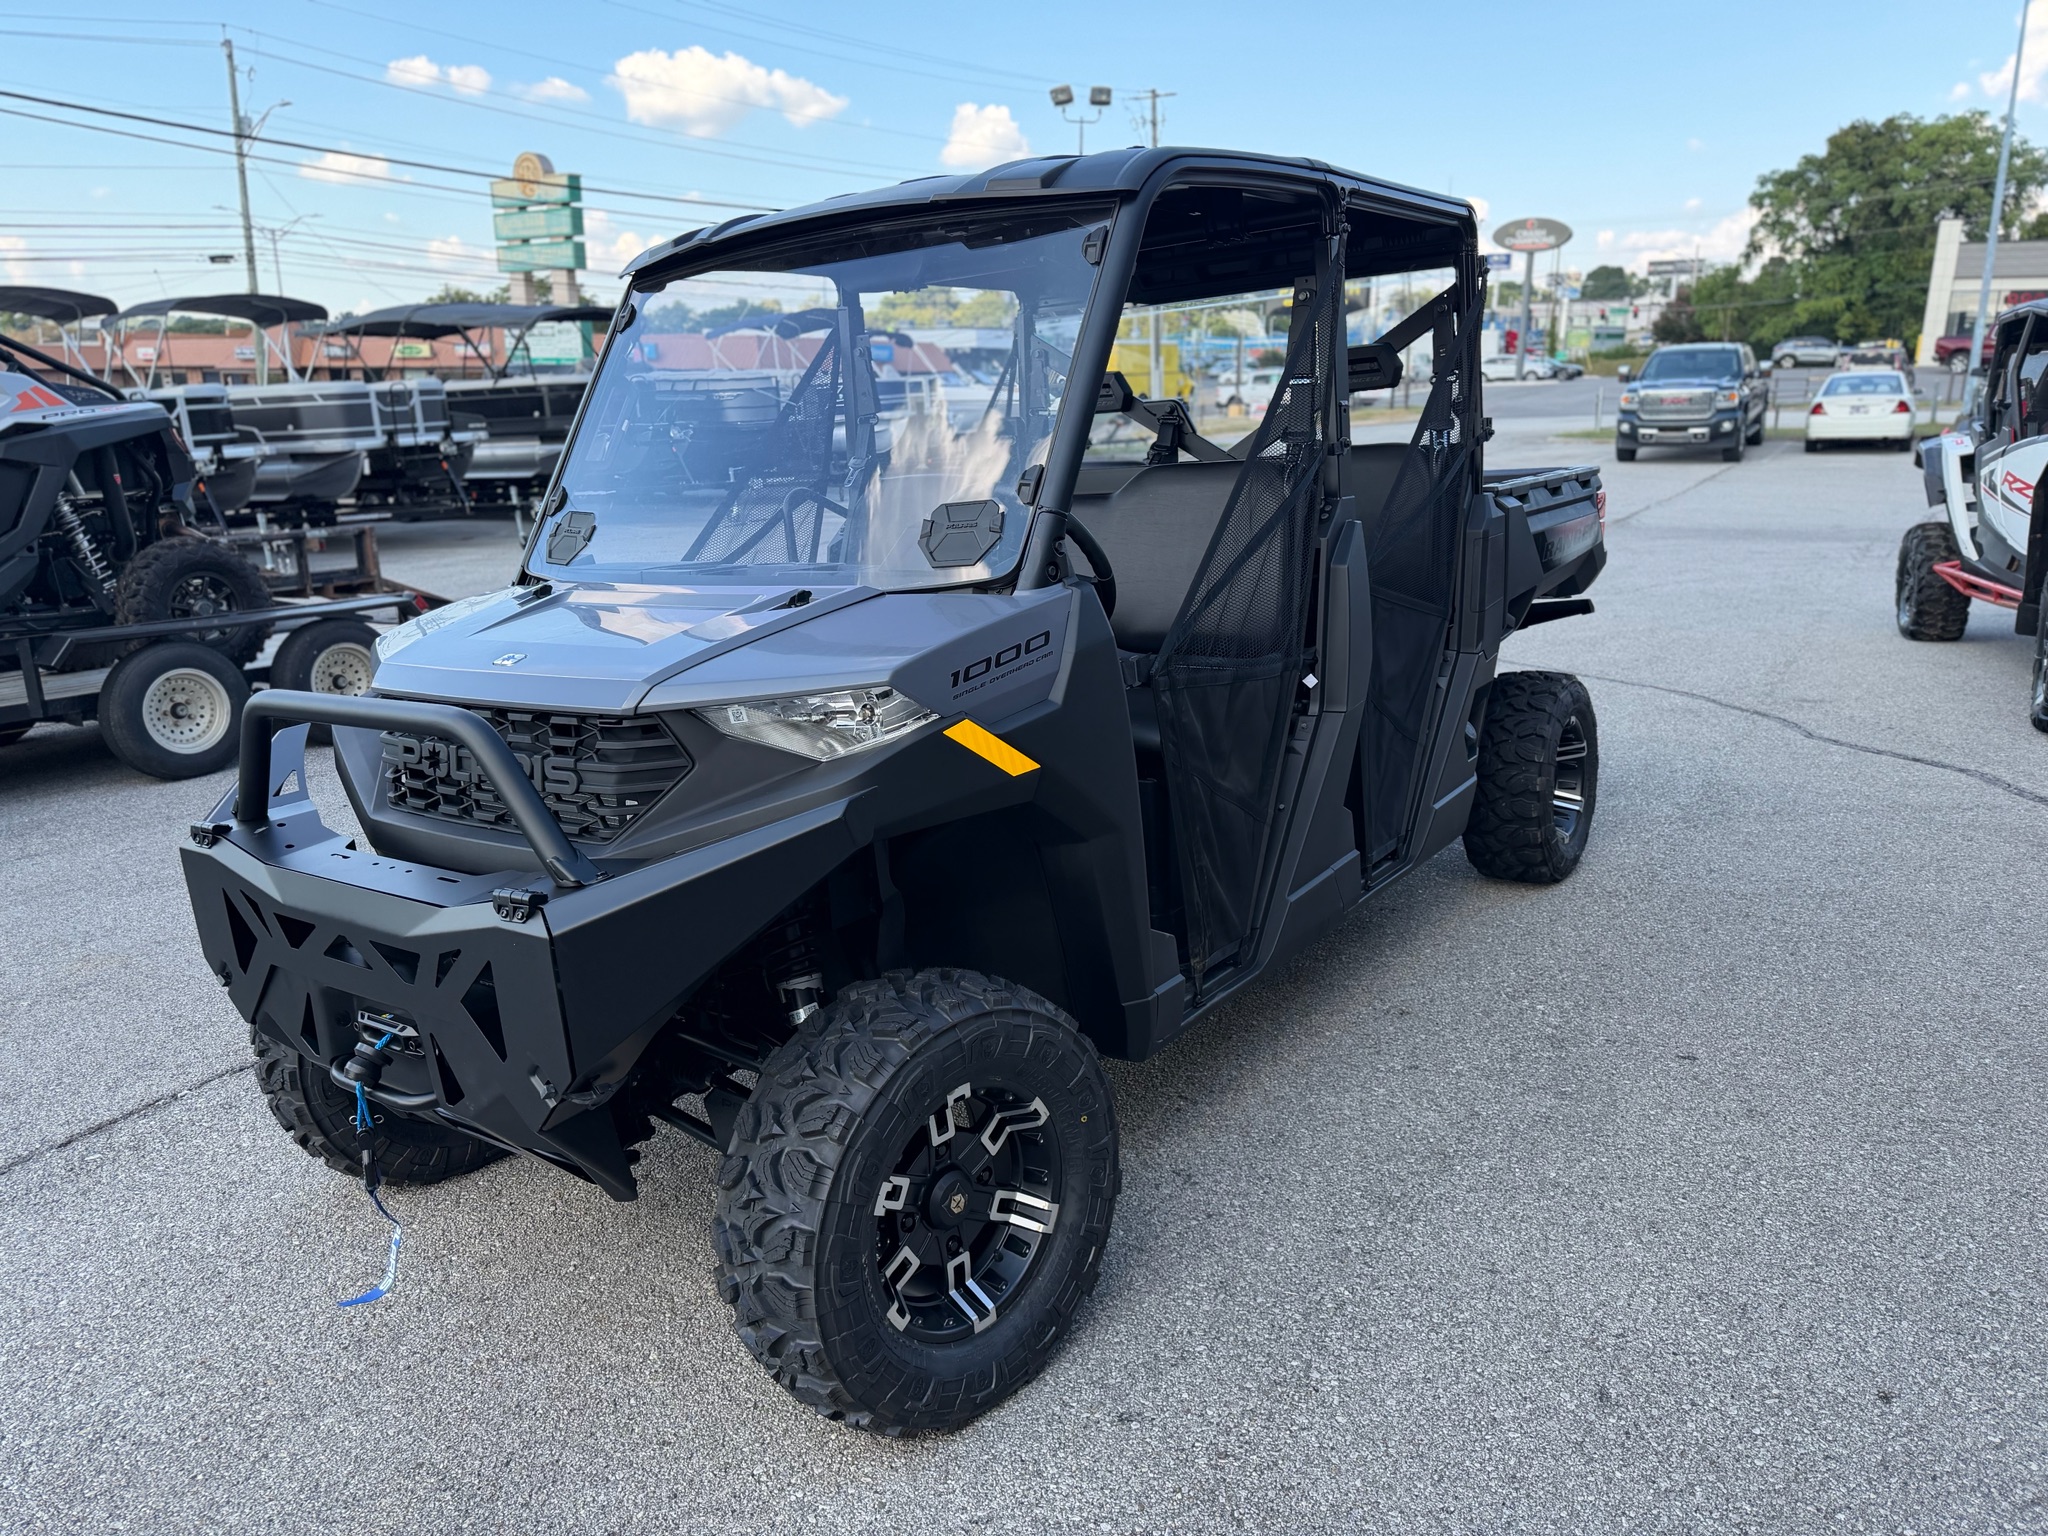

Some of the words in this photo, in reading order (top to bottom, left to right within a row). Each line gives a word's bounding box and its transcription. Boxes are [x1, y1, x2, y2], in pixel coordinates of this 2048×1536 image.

[42, 408, 96, 420] PRO
[2001, 470, 2035, 504] RZ
[950, 630, 1051, 689] 1000
[952, 681, 987, 701] SINGLE
[989, 660, 1034, 684] OVERHEAD
[1036, 650, 1054, 663] CAM
